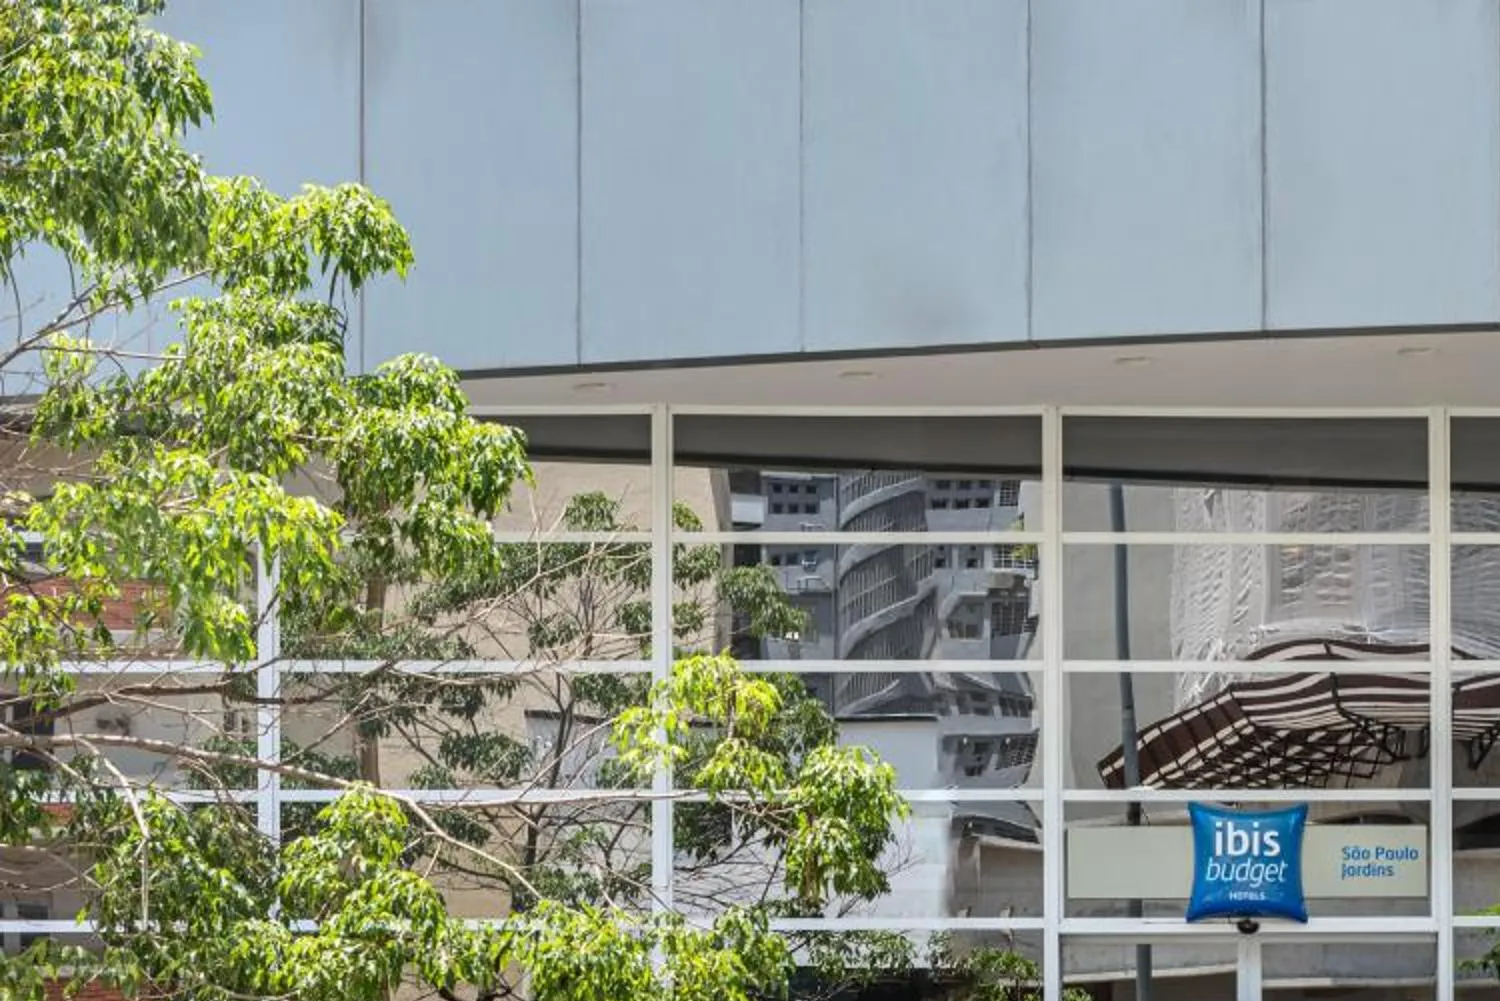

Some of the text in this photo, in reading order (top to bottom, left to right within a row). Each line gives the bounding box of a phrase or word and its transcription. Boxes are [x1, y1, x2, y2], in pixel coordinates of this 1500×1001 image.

[1215, 821, 1281, 856] ibis
[1341, 846, 1419, 860] São Paulo
[1205, 857, 1288, 888] budget
[1229, 891, 1266, 901] HOTELS
